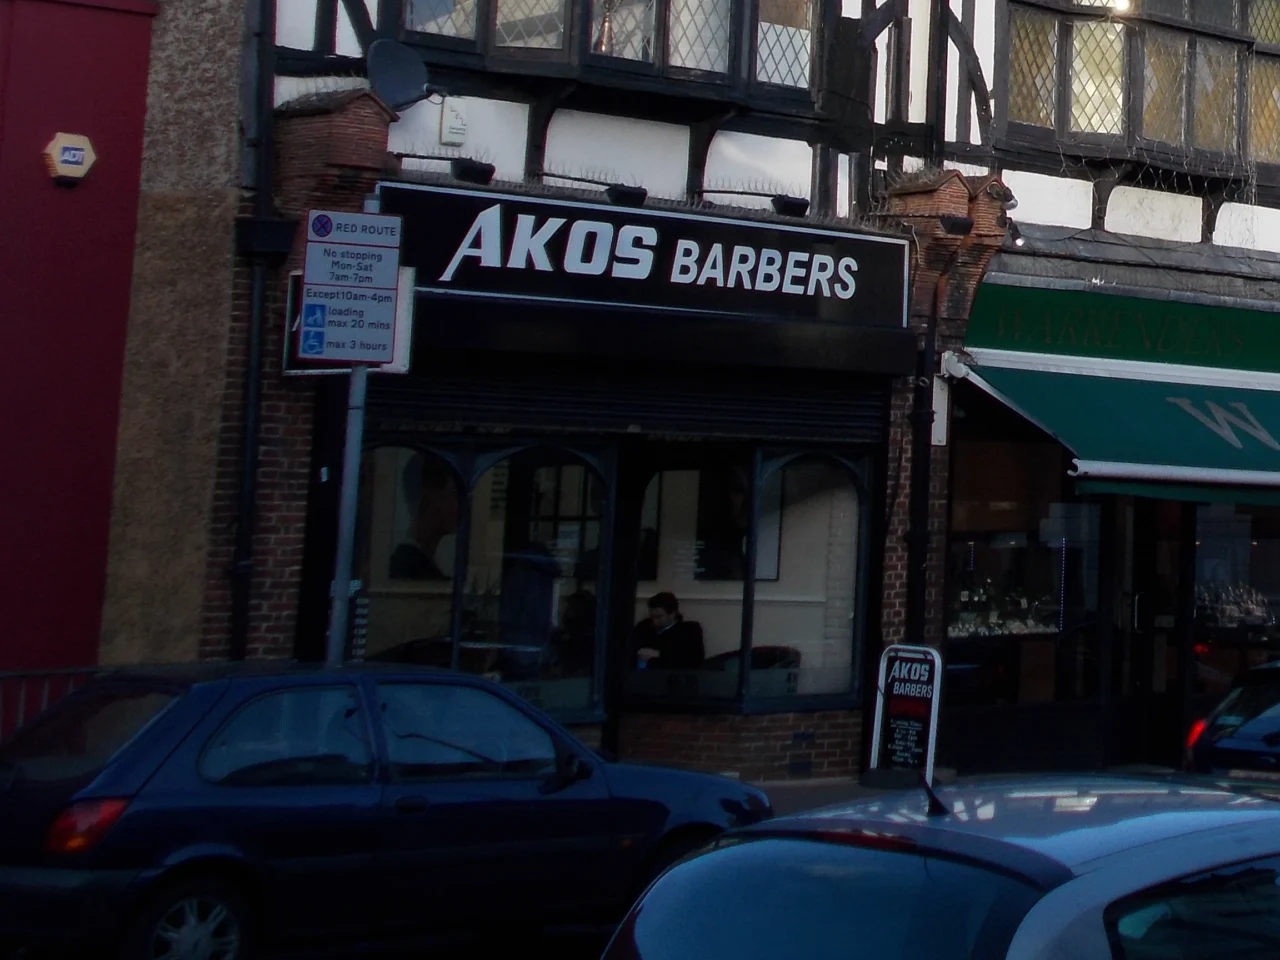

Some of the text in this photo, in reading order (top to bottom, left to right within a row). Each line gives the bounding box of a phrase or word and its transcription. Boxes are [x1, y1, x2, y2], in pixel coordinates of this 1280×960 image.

[336, 222, 397, 236] RED ROUTE
[323, 248, 382, 262] No stopping
[438, 203, 858, 299] AKOS BARBERS
[331, 260, 373, 272] Mon-Sat
[329, 271, 373, 283] 7am-7pm
[328, 306, 364, 318] loading
[327, 320, 391, 330] max 20 mins
[326, 340, 387, 350] max 3 hours
[888, 659, 930, 683] AKOS
[893, 681, 932, 699] BARBERS
